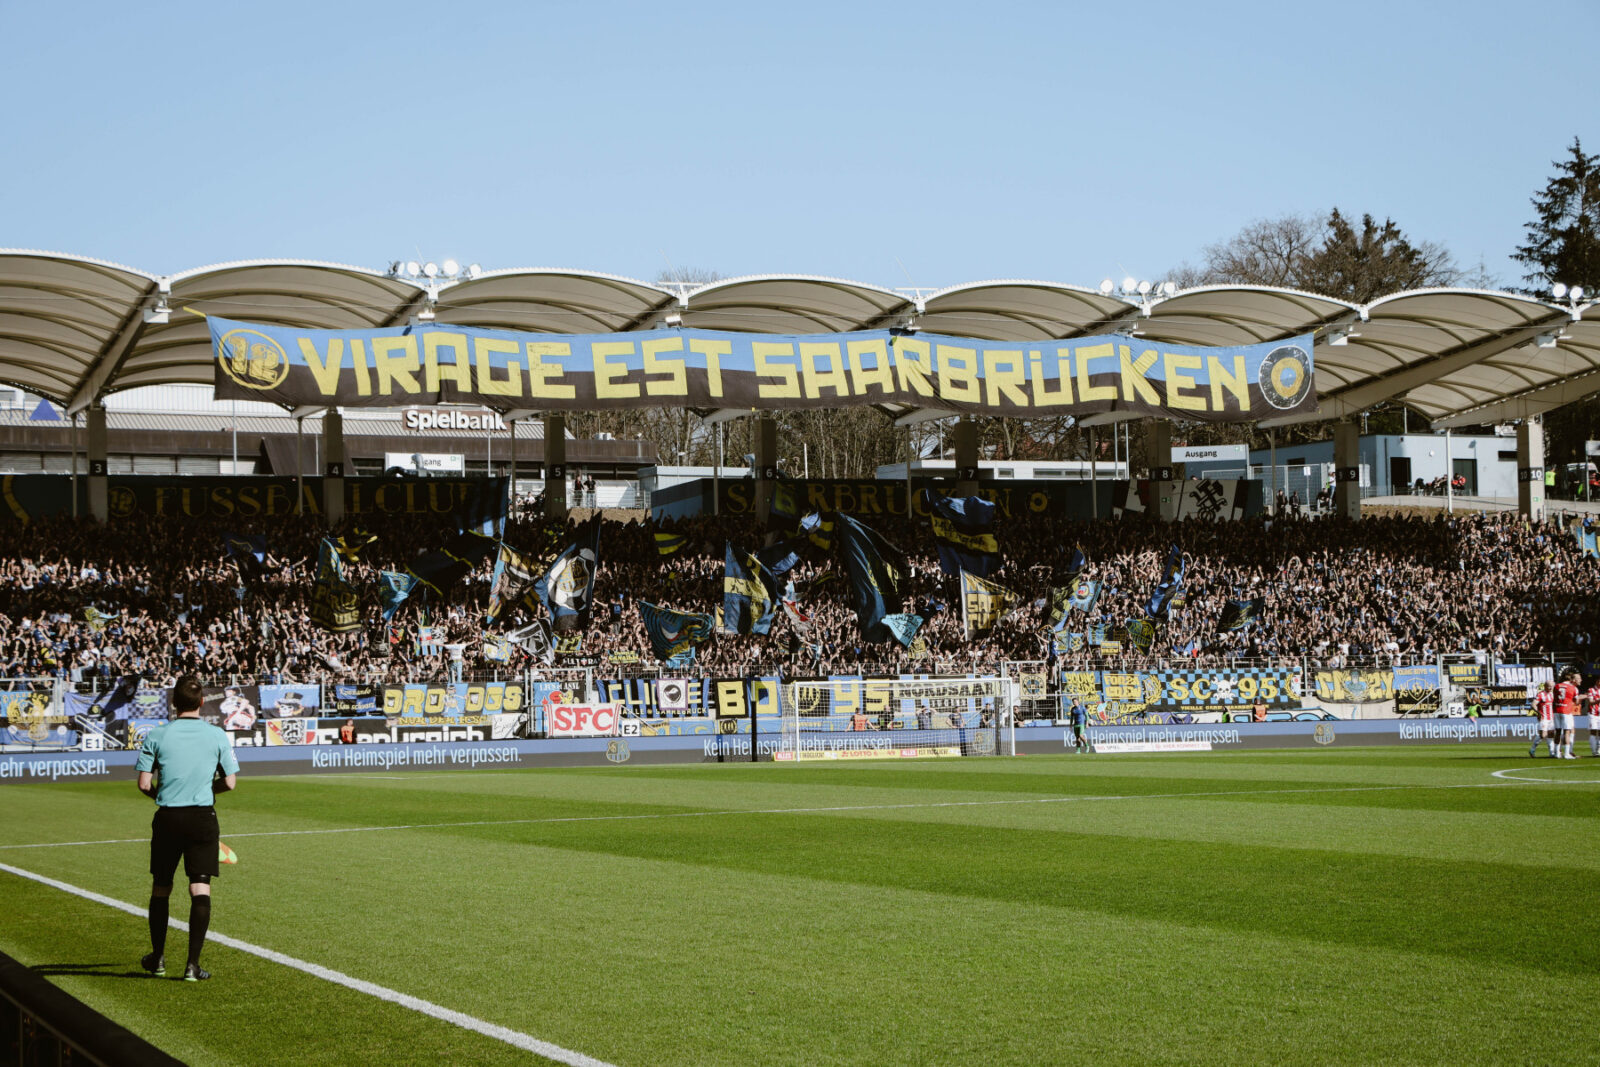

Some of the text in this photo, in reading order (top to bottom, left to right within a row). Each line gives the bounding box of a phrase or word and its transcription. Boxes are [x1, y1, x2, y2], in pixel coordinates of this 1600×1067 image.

[297, 331, 576, 398] VIRAGE
[590, 336, 734, 399] EST
[752, 336, 1251, 412] SAARBRÜCKEN
[406, 410, 507, 430] Spielbank
[1185, 450, 1218, 458] Ausgang
[95, 464, 102, 473] 3
[331, 465, 339, 475] 4
[555, 467, 561, 477] 5
[766, 468, 773, 477] 6
[967, 469, 974, 479] 7
[1162, 471, 1168, 479] 8
[1349, 470, 1356, 479] 9
[1531, 470, 1542, 479] 10
[1449, 666, 1480, 675] UNITY
[608, 682, 702, 705] CLIE
[1169, 677, 1279, 700] SC 95
[1492, 690, 1526, 700] SOCIETAS
[1450, 706, 1462, 716] E4
[554, 706, 613, 731] SFC
[624, 725, 638, 735] E2
[1399, 722, 1423, 740] Kein
[1425, 722, 1478, 742] Heimspiel
[1480, 720, 1508, 737] mehr
[1149, 727, 1177, 743] mehr
[1180, 728, 1242, 744] verpassen.
[85, 738, 100, 749] E1
[703, 739, 730, 757] Kein
[312, 744, 522, 770] Kein Heimspiel mehr verpassen.
[28, 758, 110, 780] verpassen.
